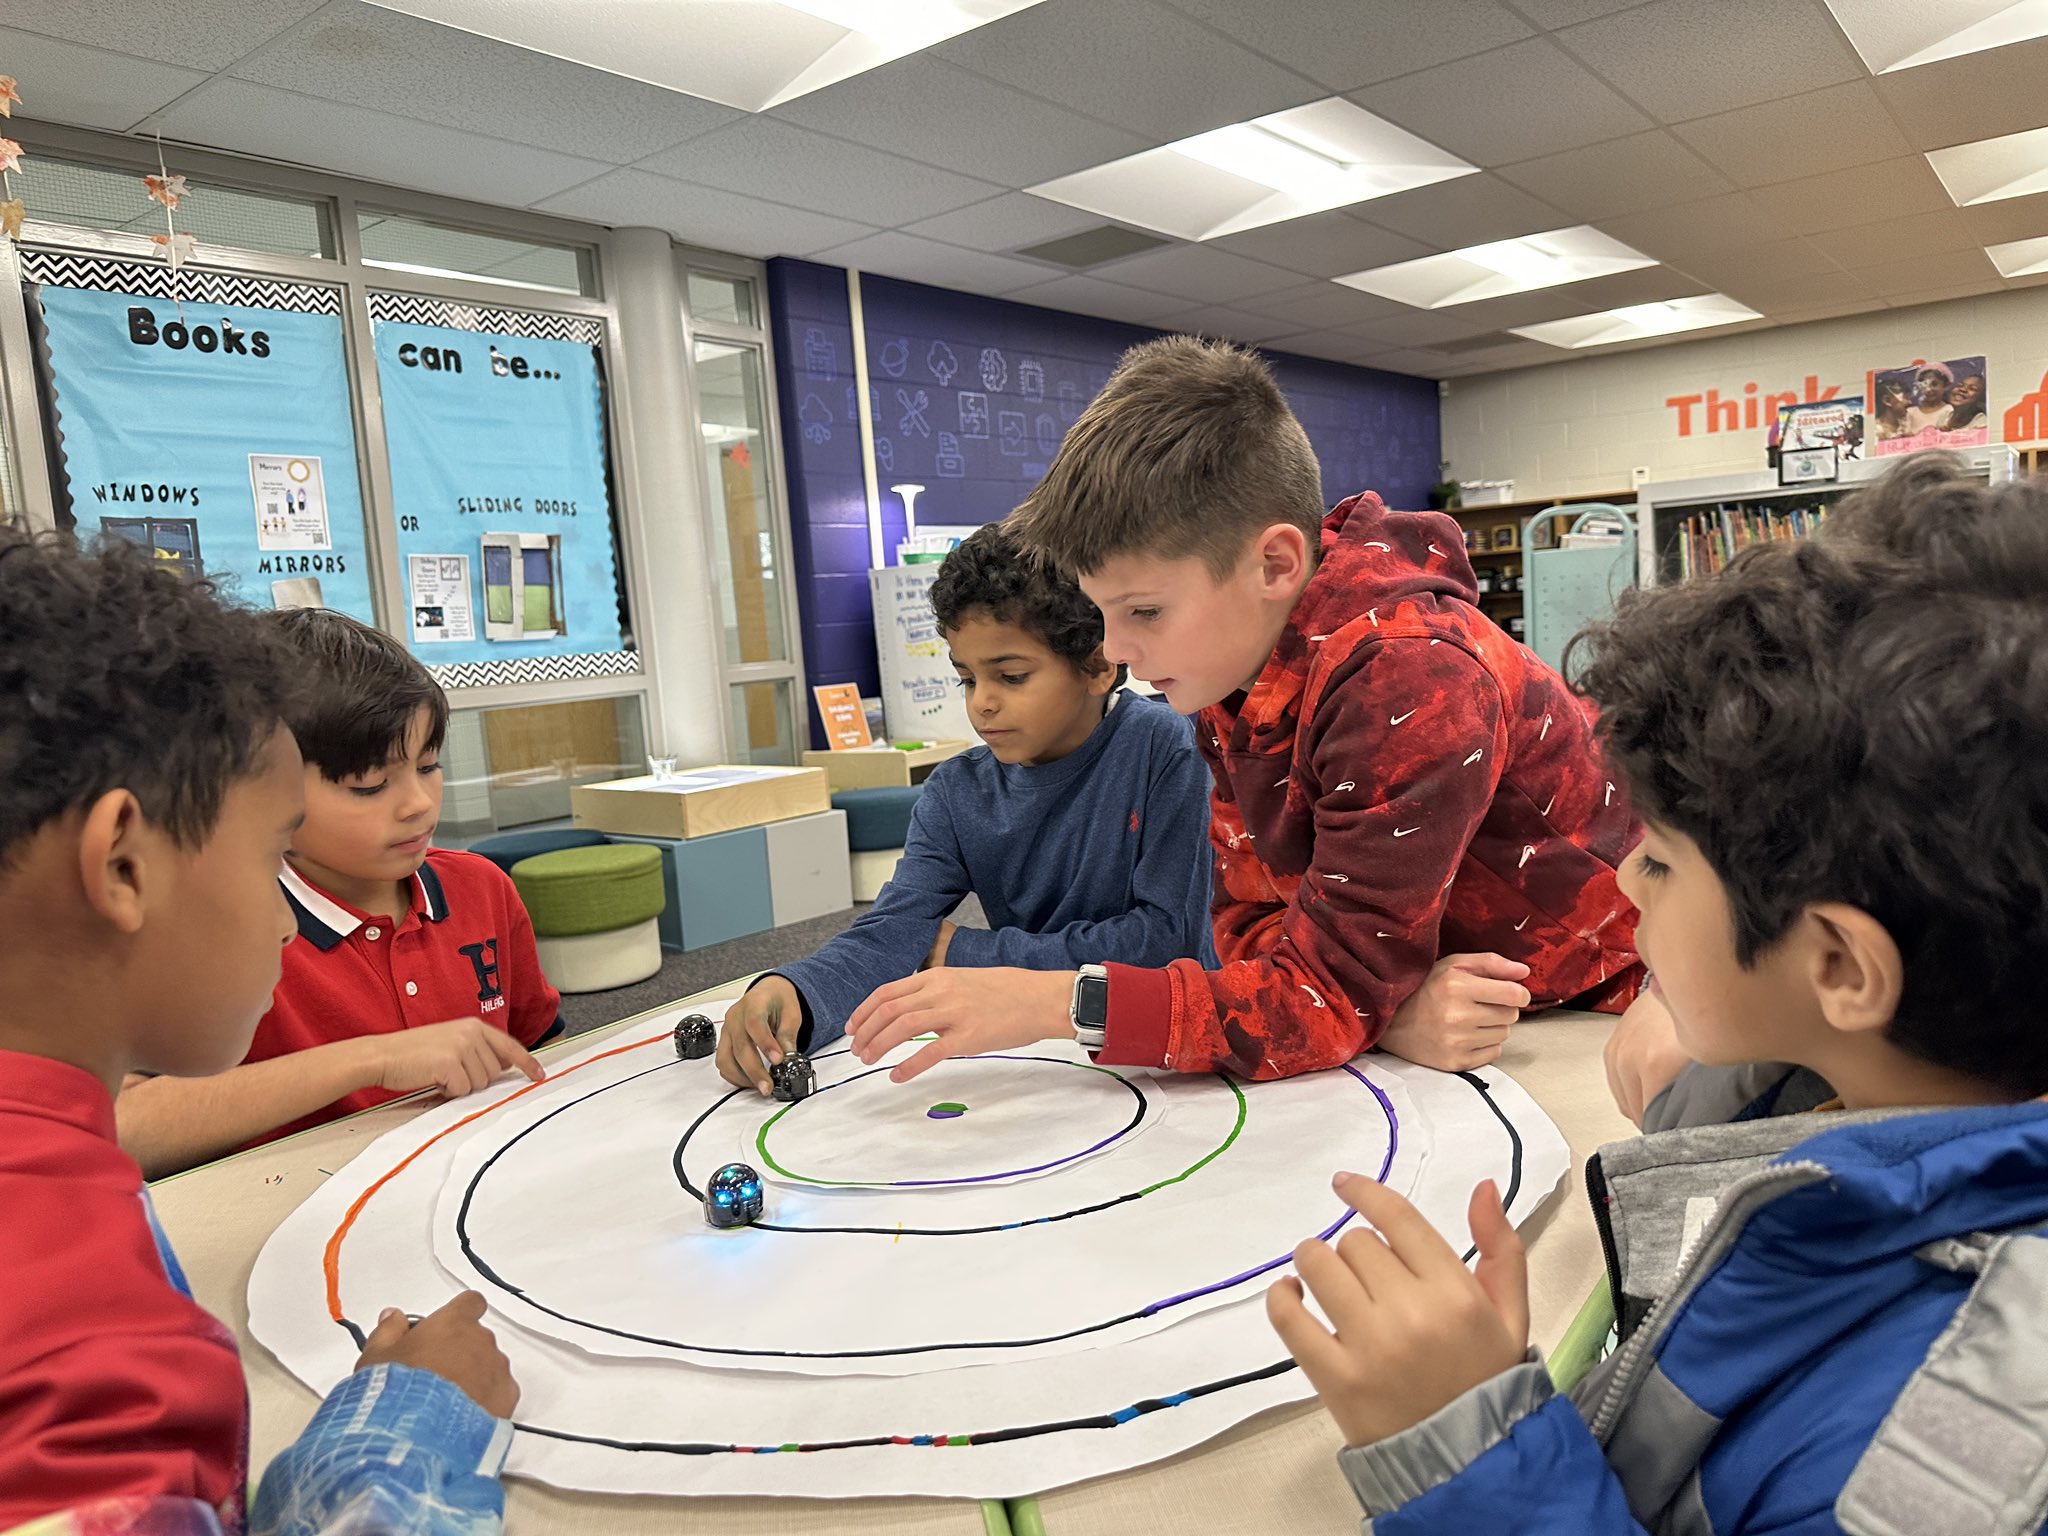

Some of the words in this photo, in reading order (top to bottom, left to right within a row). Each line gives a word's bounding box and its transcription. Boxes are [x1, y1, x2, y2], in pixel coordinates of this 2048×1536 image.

[128, 305, 270, 358] Books
[399, 343, 463, 373] can
[92, 482, 200, 507] WINDOWS
[535, 499, 578, 517] DOORS
[401, 515, 420, 531] OR
[258, 555, 346, 574] MIRRORS
